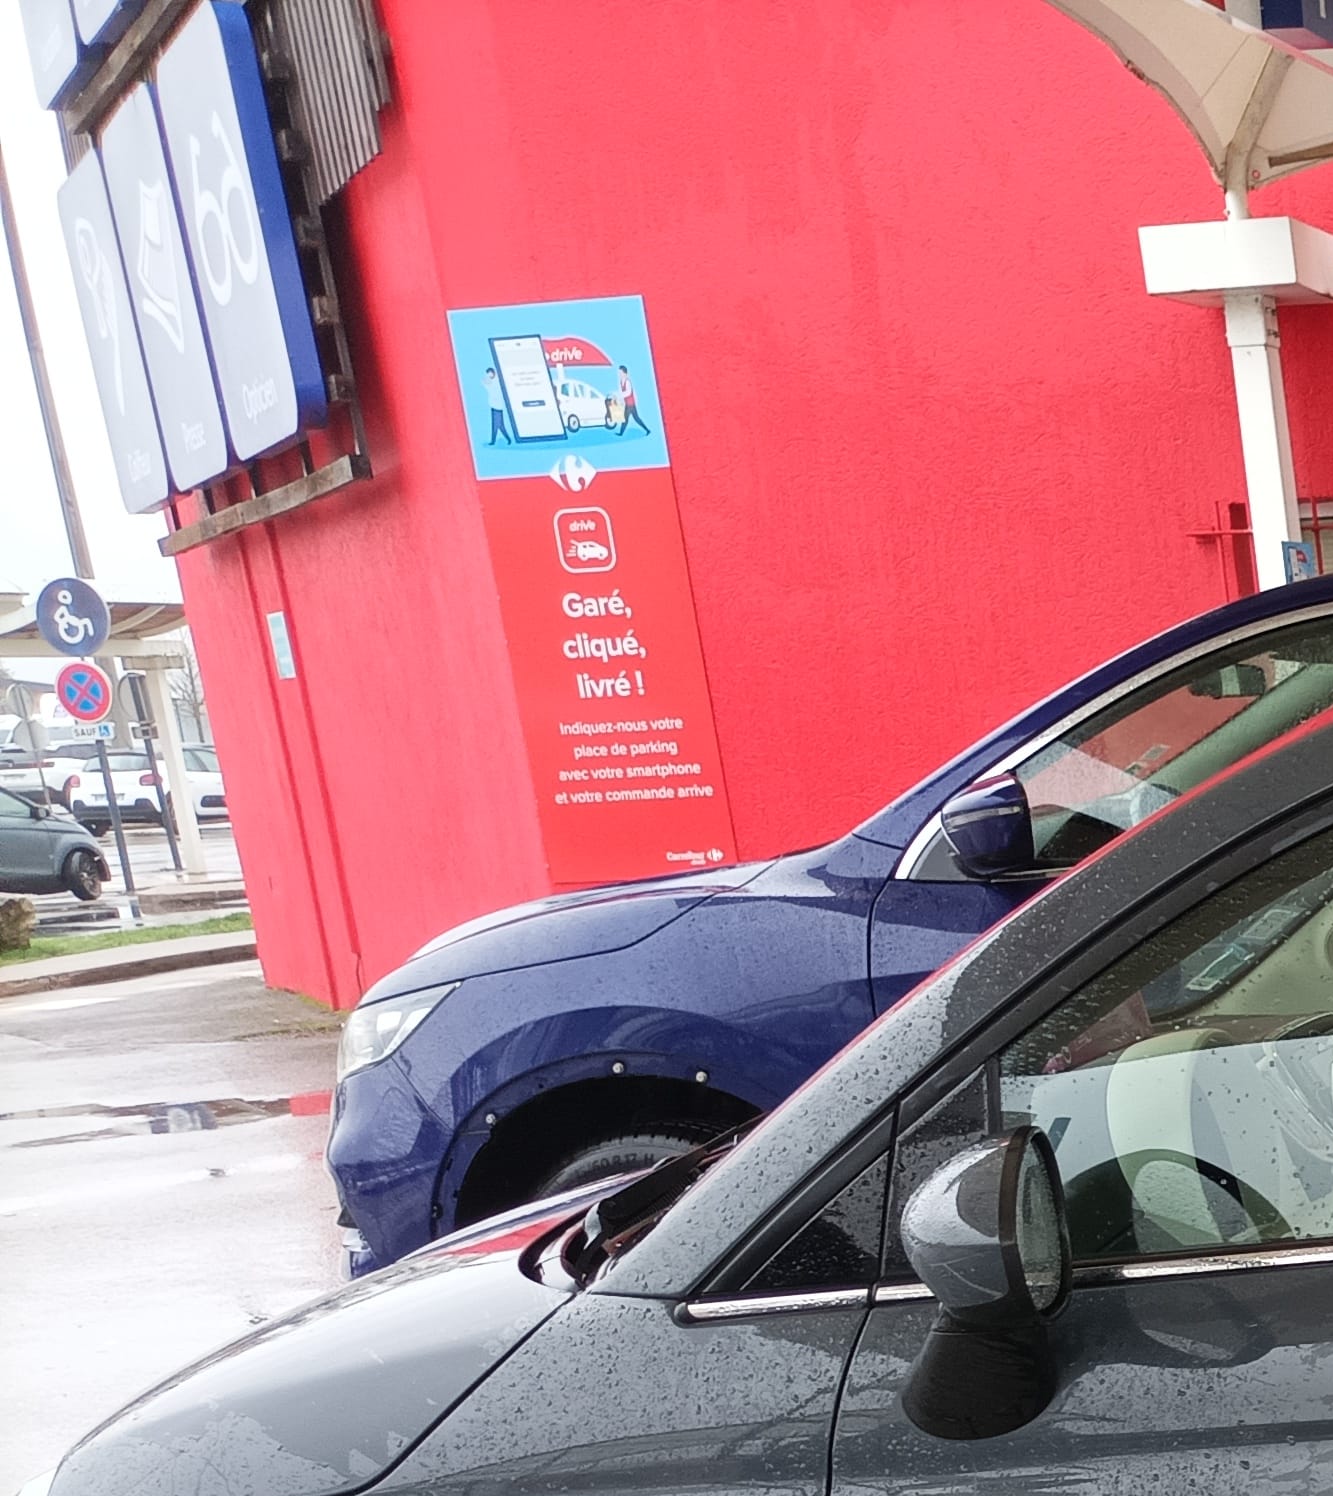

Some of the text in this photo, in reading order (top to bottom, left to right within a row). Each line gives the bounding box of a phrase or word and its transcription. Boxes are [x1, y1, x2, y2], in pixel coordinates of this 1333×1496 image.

[550, 347, 583, 362] drive
[569, 520, 596, 532] drive
[562, 589, 632, 618] Garé,
[563, 629, 646, 662] cliqué,
[576, 670, 631, 699] livré
[74, 728, 96, 737] SAUF
[560, 717, 683, 736] Indiquez-nous votre
[573, 740, 678, 760] place de parking
[559, 762, 701, 781] avec votre smartphone
[555, 784, 713, 804] et votre commande arrive
